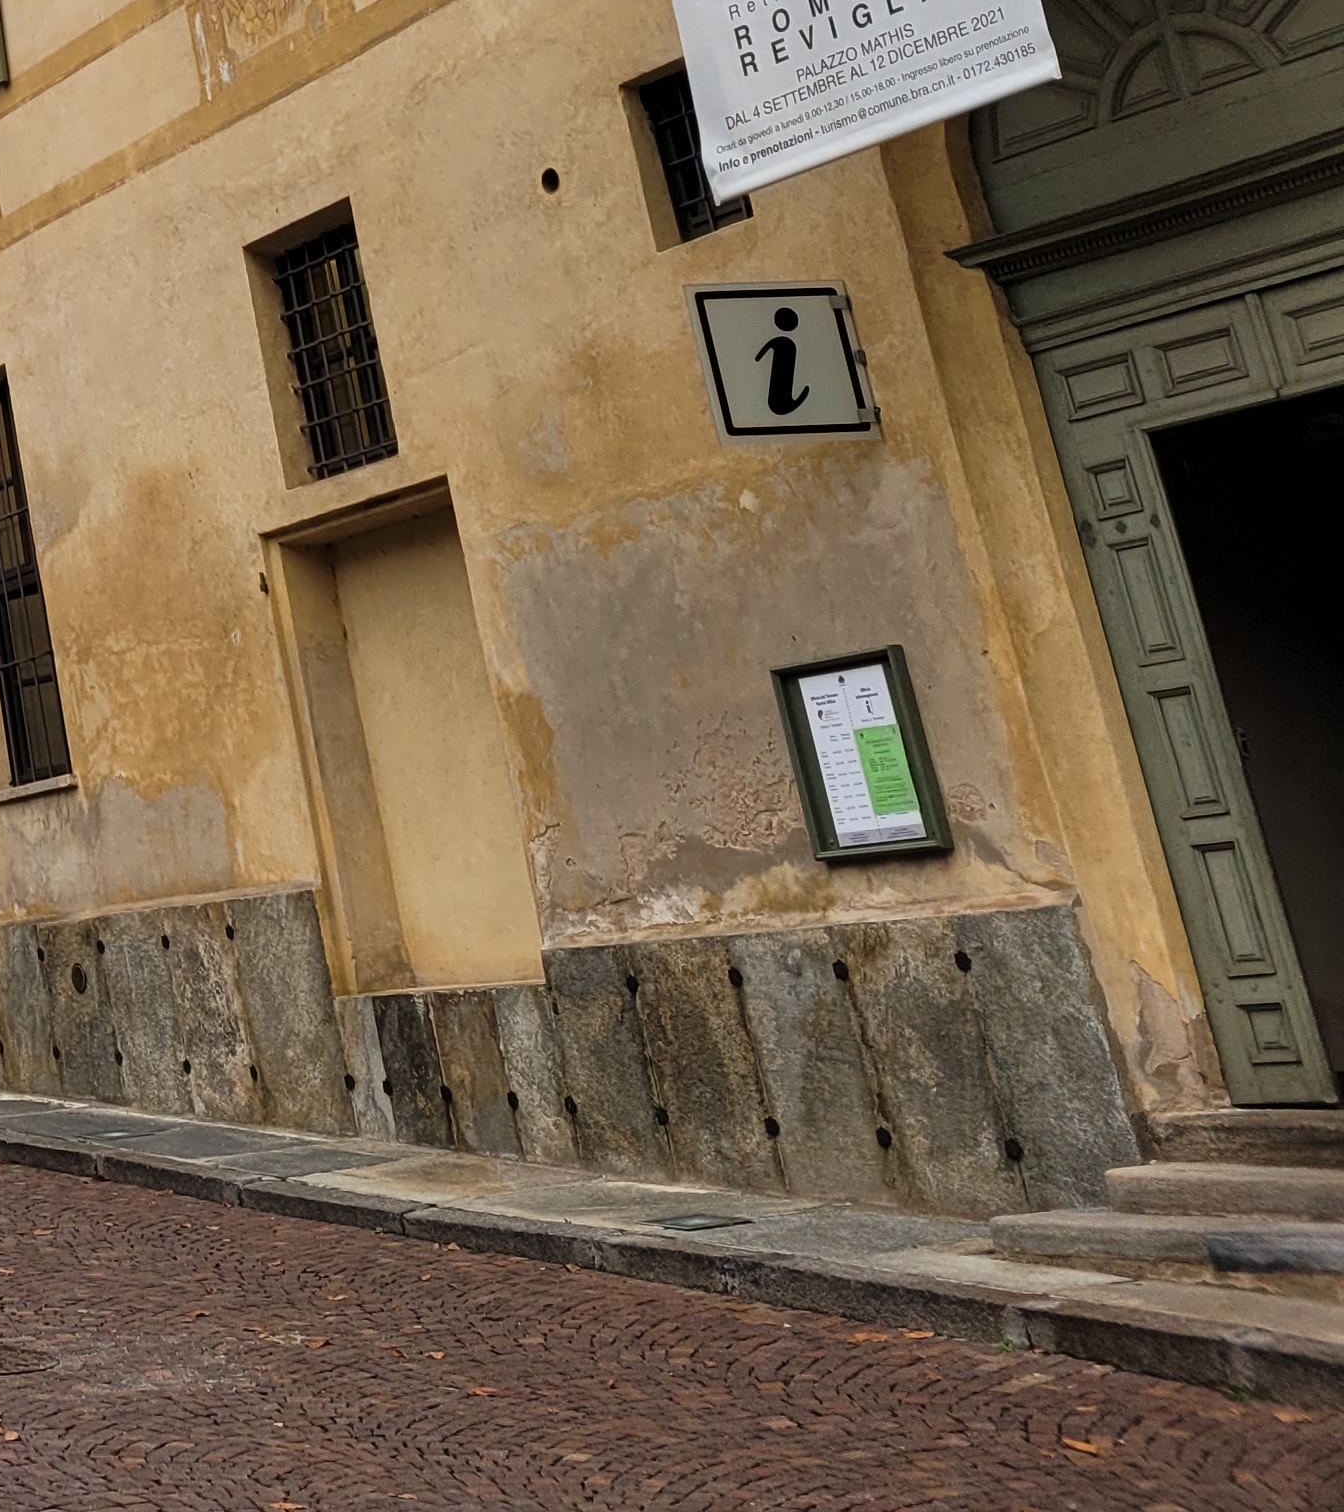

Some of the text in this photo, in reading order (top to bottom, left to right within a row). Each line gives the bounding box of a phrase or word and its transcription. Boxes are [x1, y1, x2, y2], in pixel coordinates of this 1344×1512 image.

[725, 6, 1005, 130] DAL 4 SETTEMBRE AL 12 DICEMBRE 2021
[796, 23, 915, 83] PALAZZO MATHIS
[900, 61, 939, 81] Ingresso
[939, 53, 963, 67] libero
[963, 48, 975, 58] su
[975, 25, 1030, 56] prenotazione
[718, 158, 741, 173] Info
[742, 155, 749, 164] e
[750, 128, 814, 165] prenotazioni
[962, 42, 1036, 80] 0172.430185
